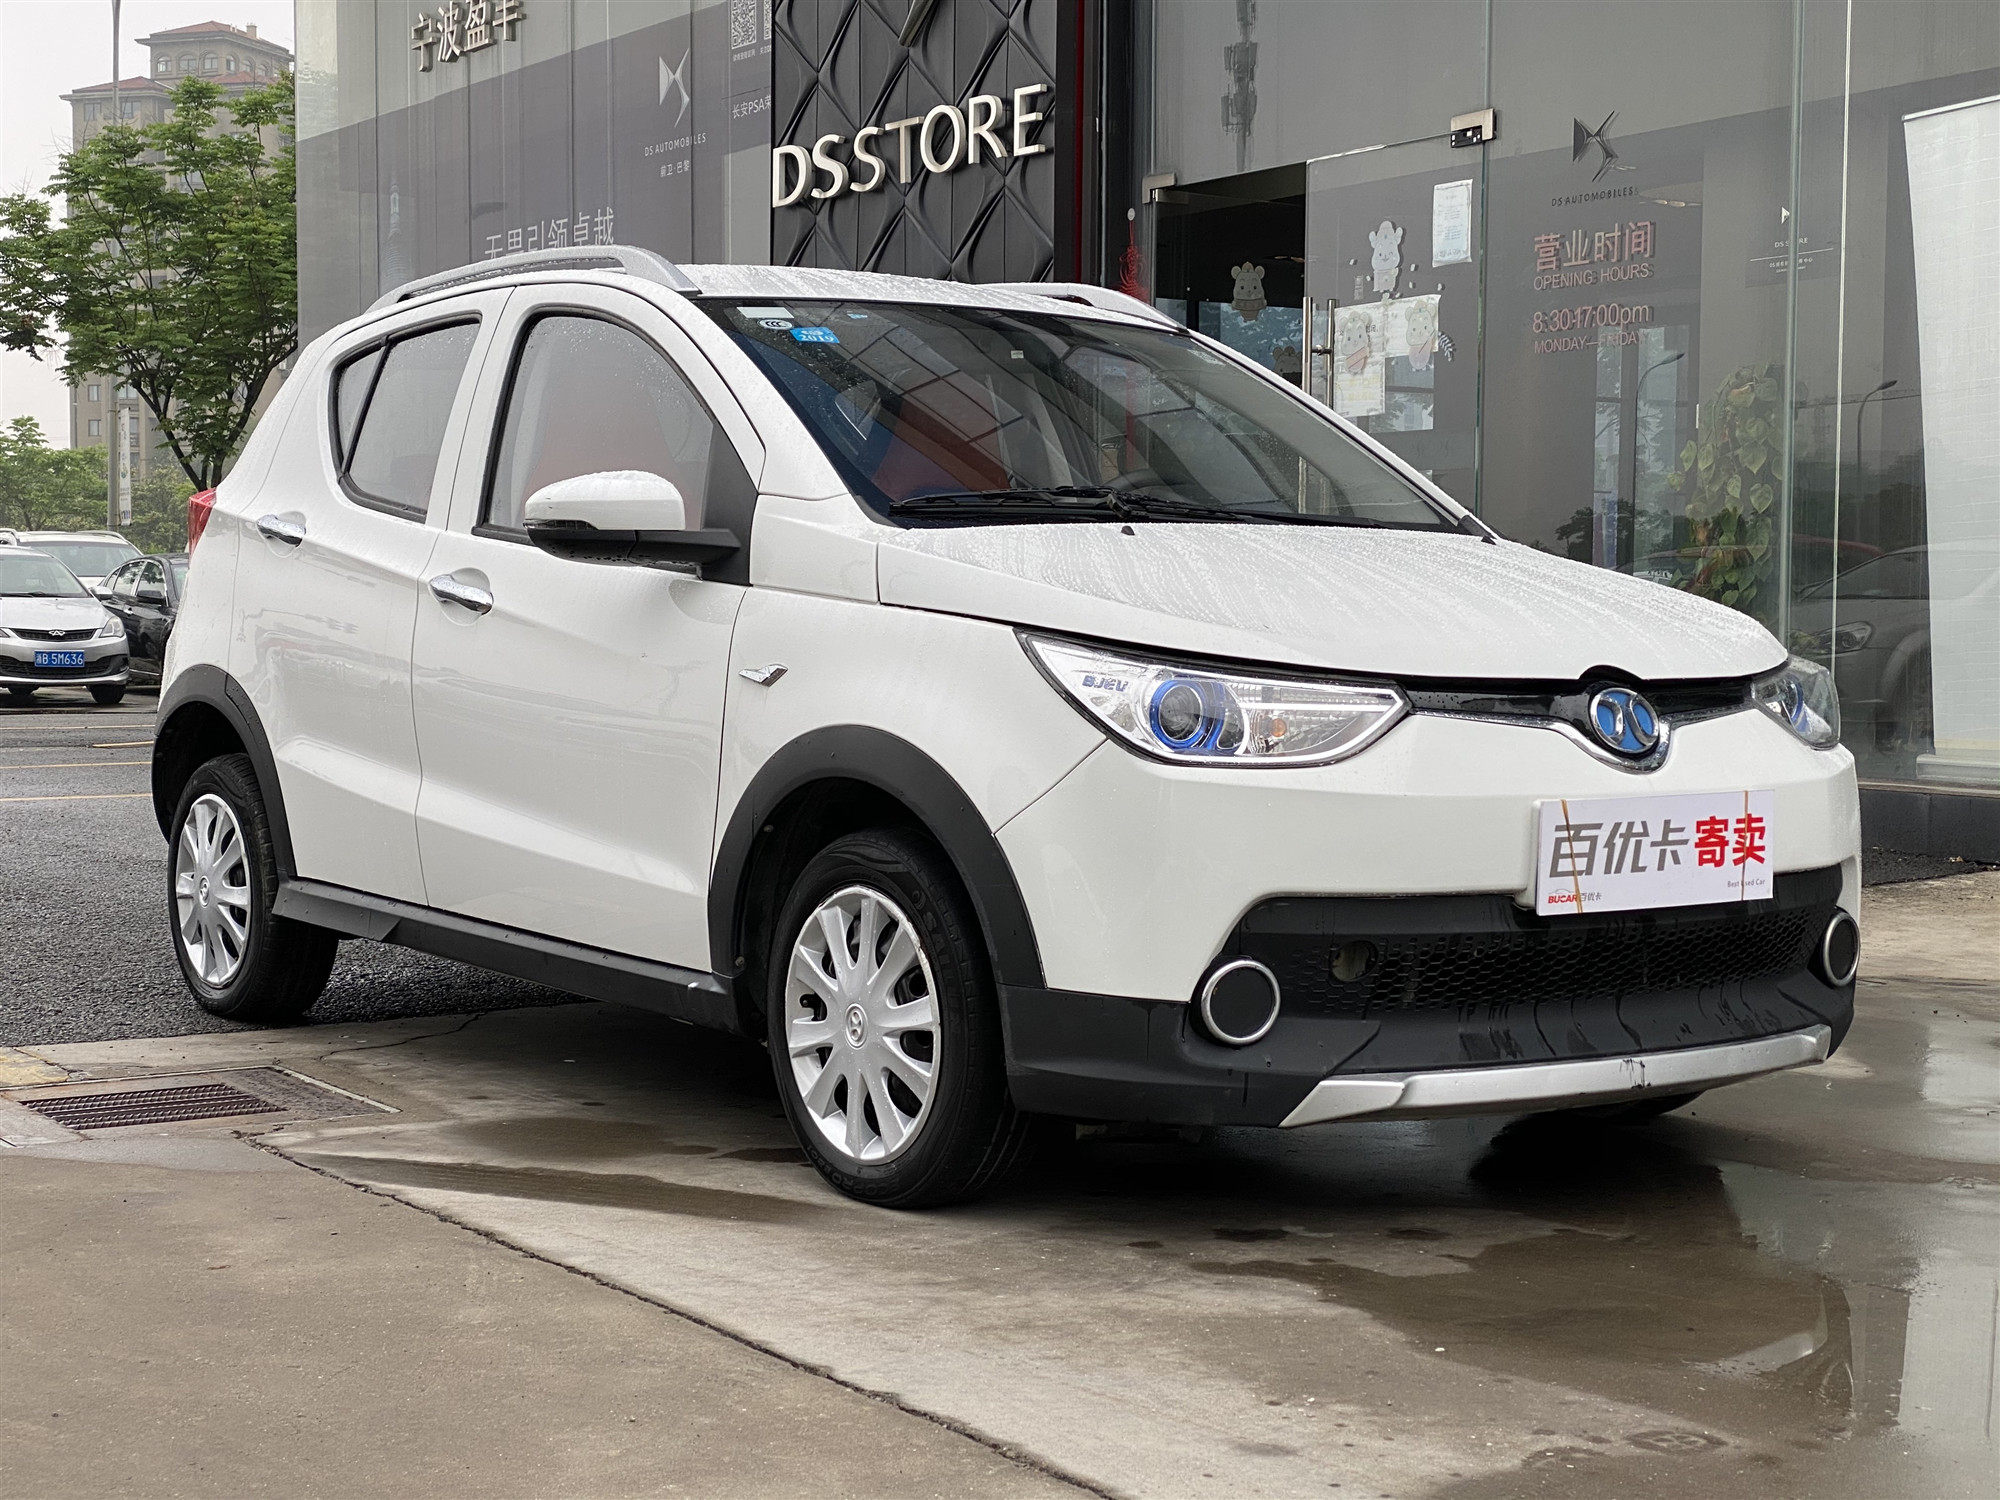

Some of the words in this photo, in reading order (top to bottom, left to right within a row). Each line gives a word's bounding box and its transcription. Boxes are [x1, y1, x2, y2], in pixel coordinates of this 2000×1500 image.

[644, 145, 654, 157] DS
[655, 132, 707, 153] AUTOMOBILES
[1551, 197, 1563, 207] DS
[1564, 186, 1634, 205] AUTOMOBILES
[1534, 221, 1651, 272] 营业时间
[1533, 269, 1593, 291] OPENING
[1600, 262, 1650, 282] HOURS
[1755, 878, 1766, 886] Car
